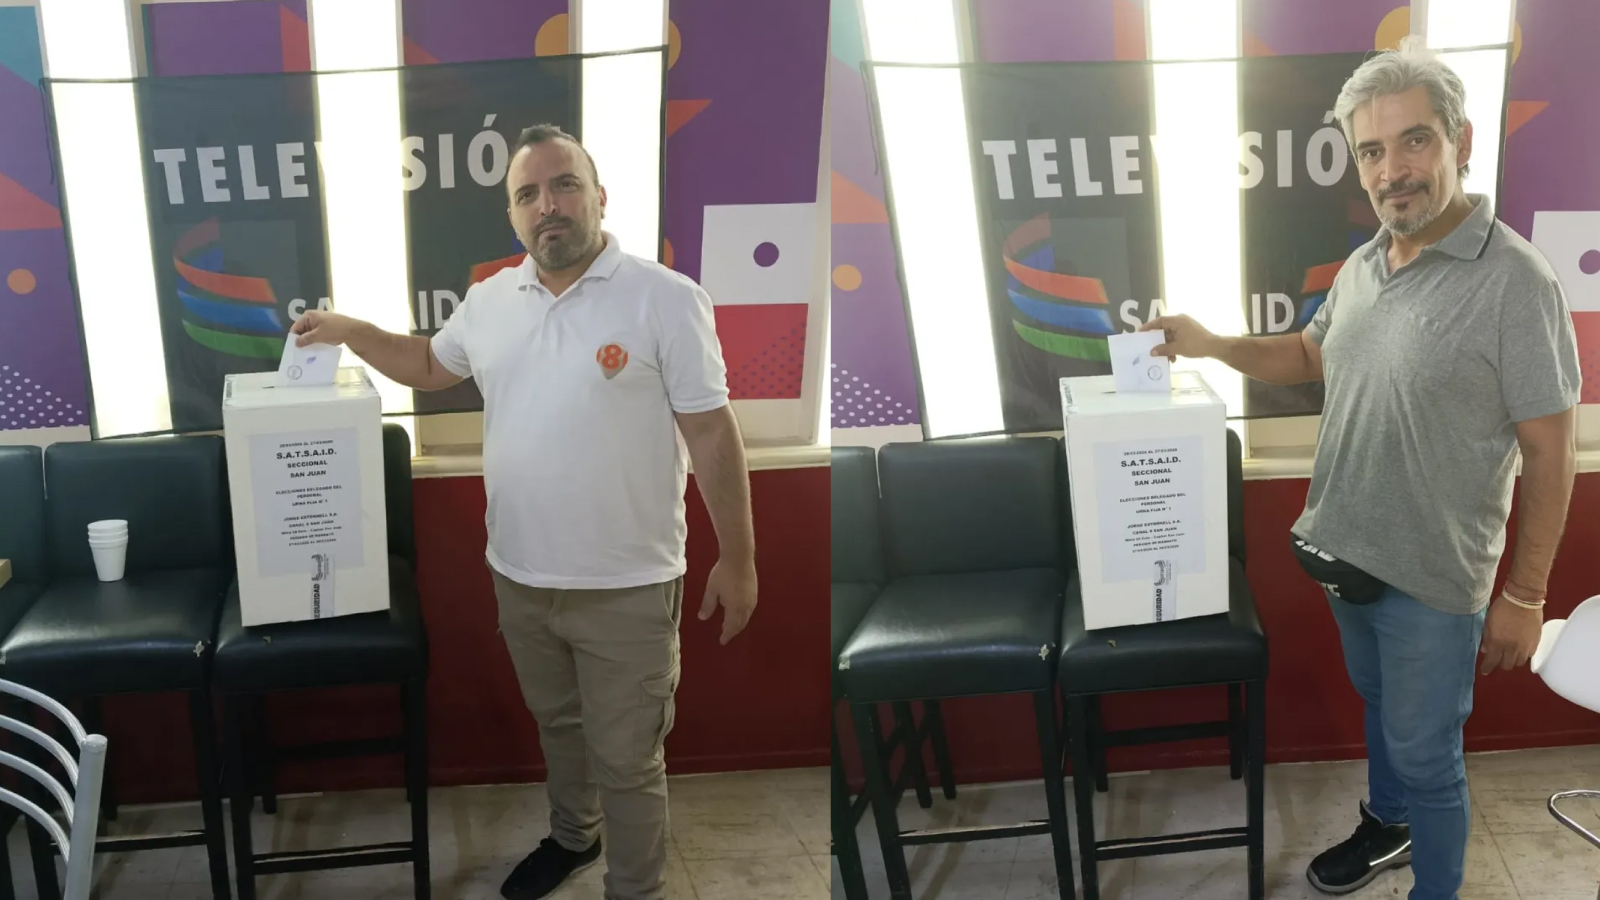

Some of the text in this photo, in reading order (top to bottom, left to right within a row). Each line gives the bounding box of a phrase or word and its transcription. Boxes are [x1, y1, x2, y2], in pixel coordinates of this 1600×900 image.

[276, 448, 337, 460] S.A.T.S.A.I.D.
[287, 460, 328, 468] SECCIONAL
[1121, 456, 1181, 467] S.A.T.S.A.I.D.
[1131, 468, 1172, 476] SECCIONAL
